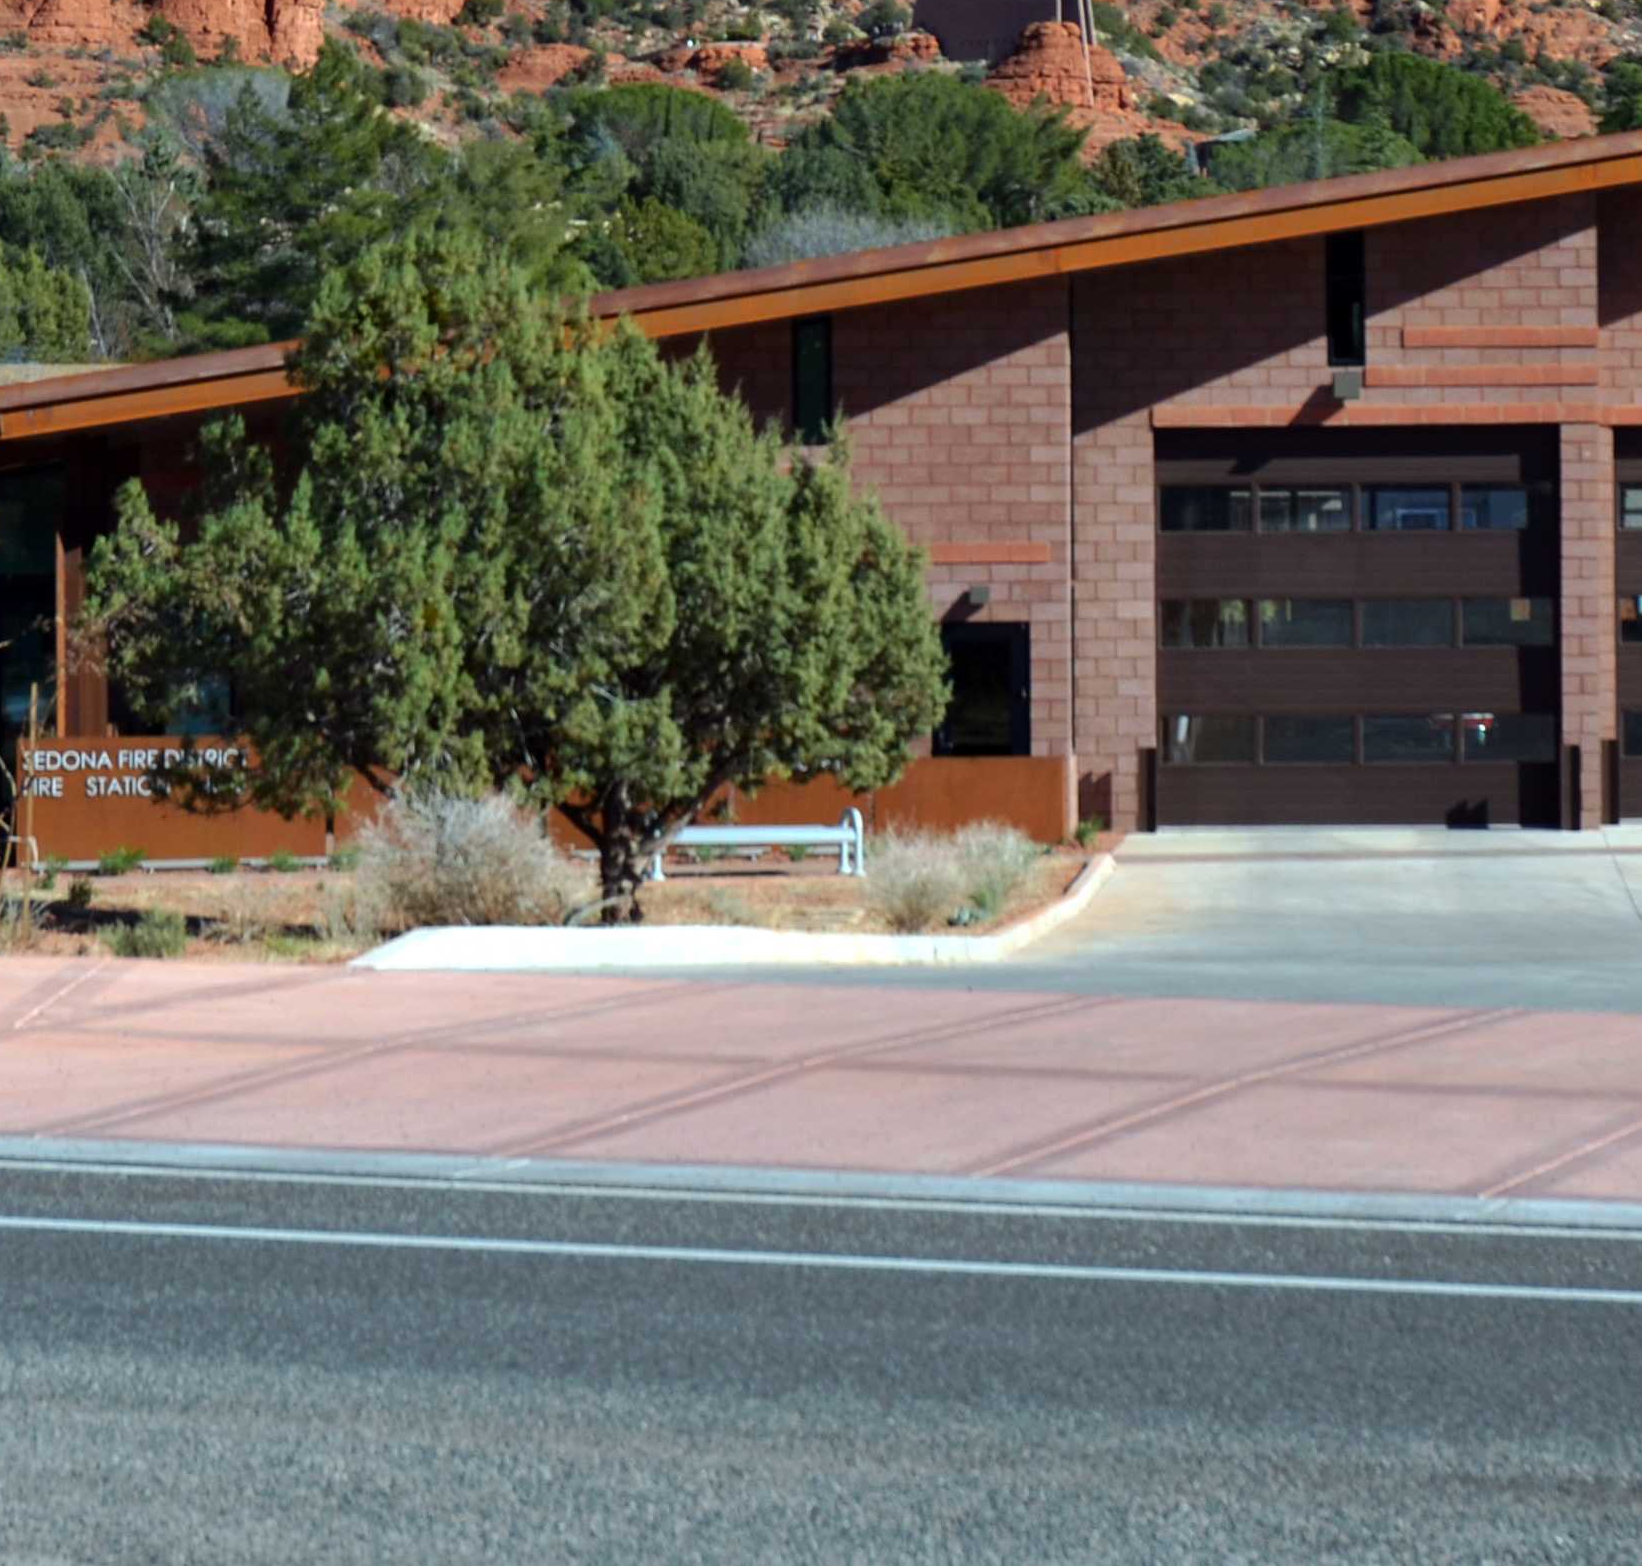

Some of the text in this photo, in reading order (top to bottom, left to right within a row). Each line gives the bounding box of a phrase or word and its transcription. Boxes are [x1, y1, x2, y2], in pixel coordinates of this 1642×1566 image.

[22, 748, 249, 771] SEDONA FIRE DTRIC
